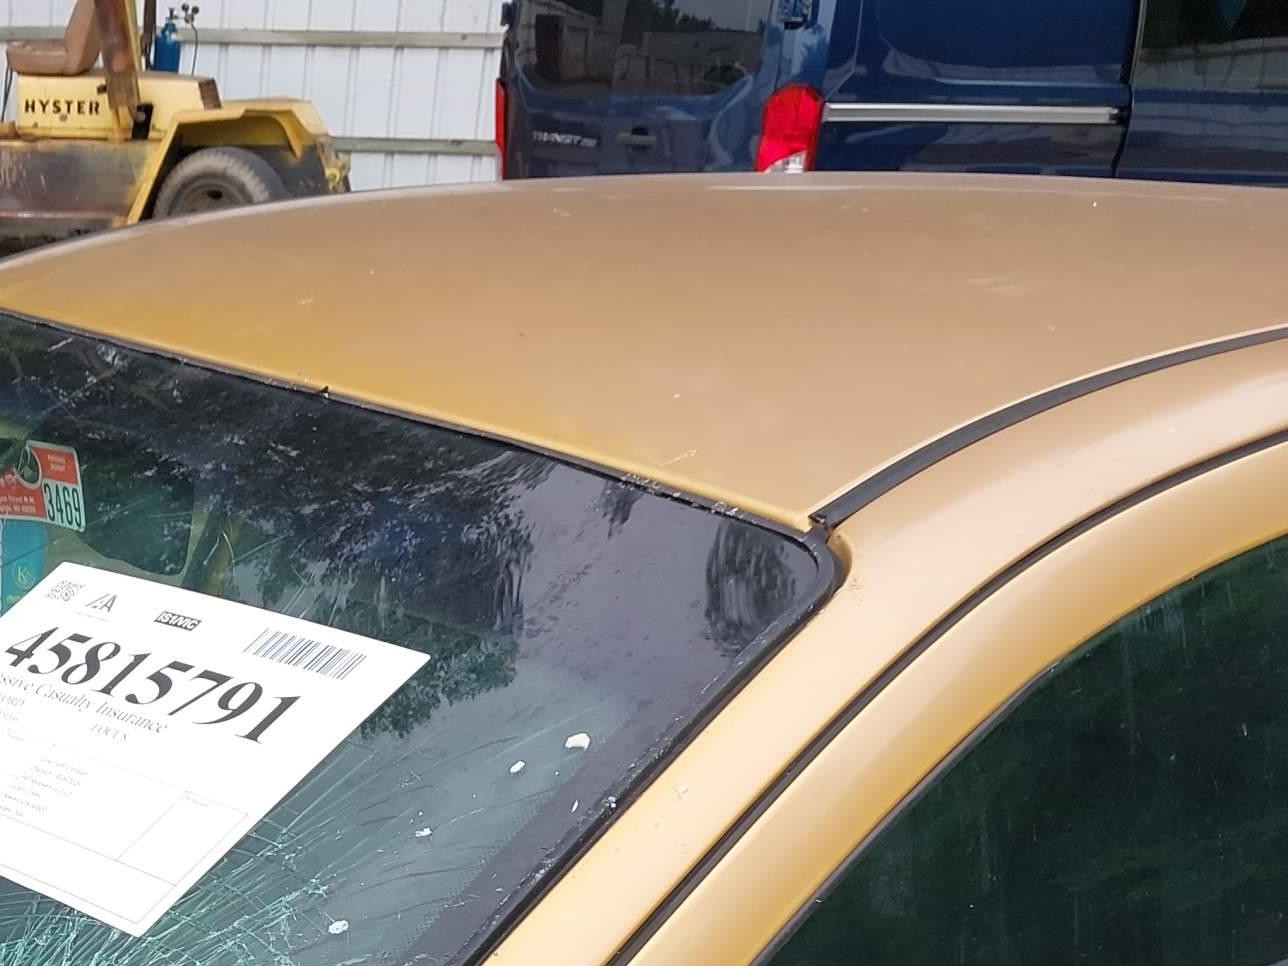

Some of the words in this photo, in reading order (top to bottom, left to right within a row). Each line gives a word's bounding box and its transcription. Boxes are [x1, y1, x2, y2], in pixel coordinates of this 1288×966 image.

[24, 98, 100, 115] HYSTER
[44, 483, 82, 528] 3469
[3, 624, 304, 745] 45815791
[34, 682, 93, 713] Casualty
[94, 700, 169, 734] Insurance
